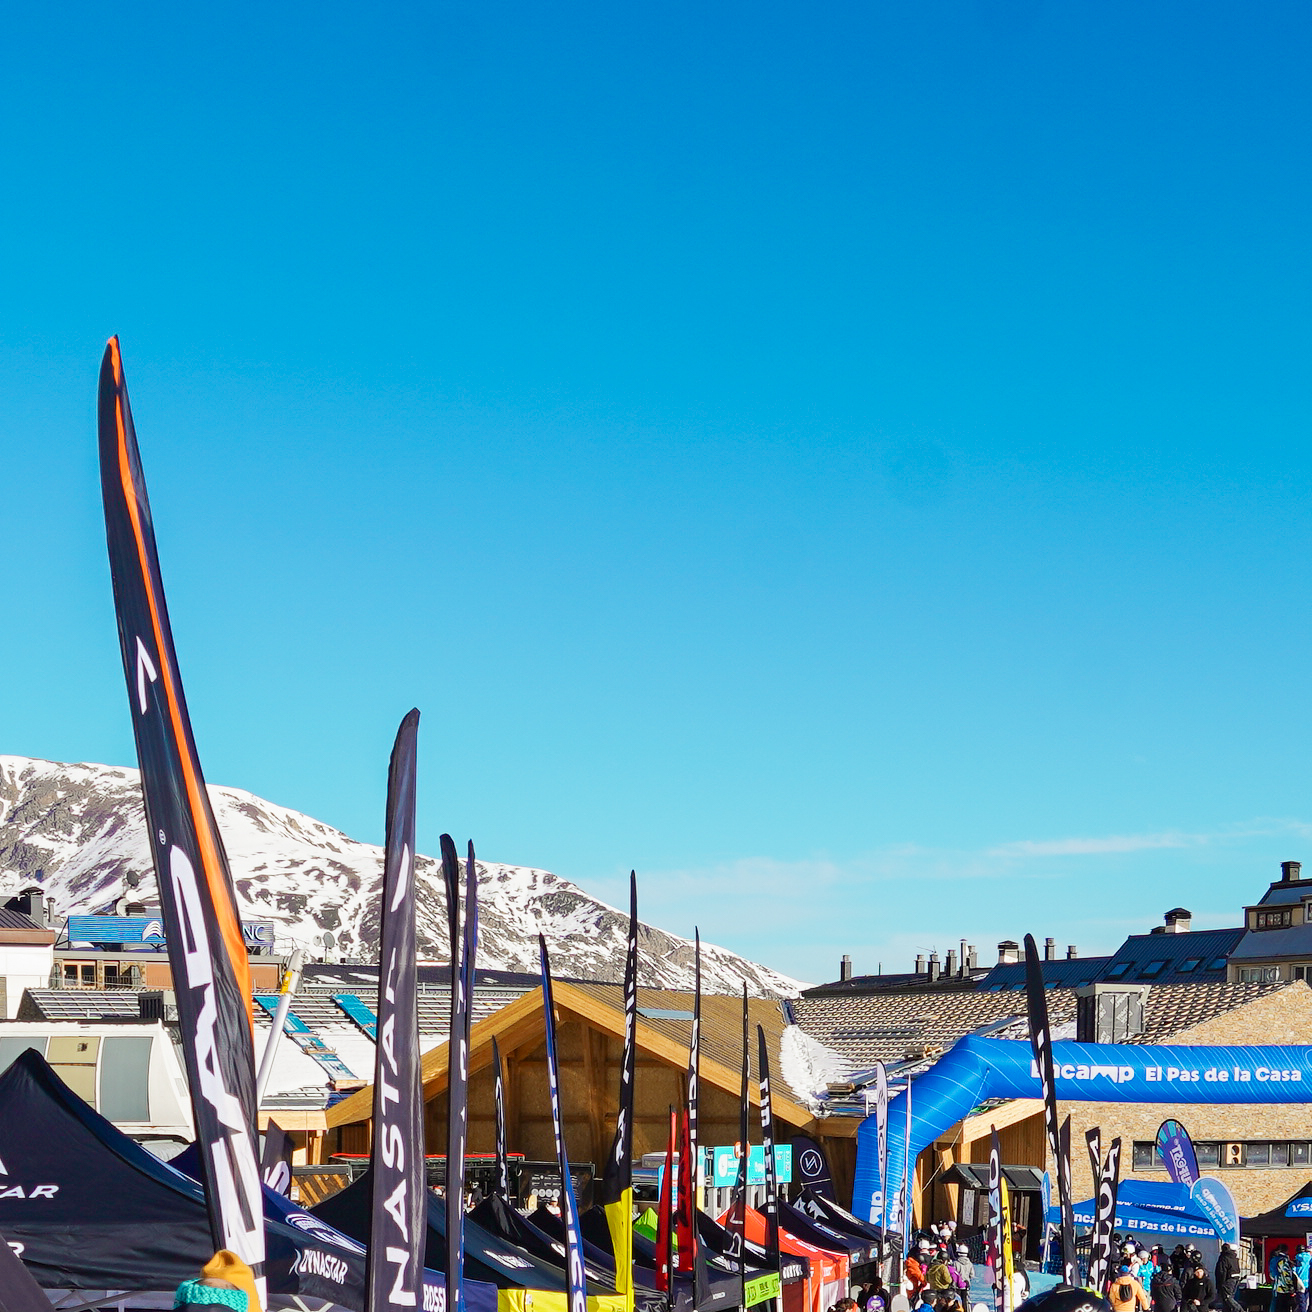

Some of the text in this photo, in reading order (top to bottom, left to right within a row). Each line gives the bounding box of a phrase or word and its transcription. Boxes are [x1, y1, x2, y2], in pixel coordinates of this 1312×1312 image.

[1145, 1067, 1161, 1082] El
[1168, 1067, 1199, 1082] Pas
[1205, 1067, 1228, 1082] de
[1234, 1067, 1250, 1082] la
[1255, 1067, 1301, 1082] Casa
[1128, 1219, 1138, 1229] El
[1140, 1221, 1159, 1231] Pas
[1160, 1222, 1175, 1232] de
[1177, 1223, 1186, 1233] la
[1188, 1225, 1215, 1236] Casa
[299, 1249, 348, 1285] DYNASTAR
